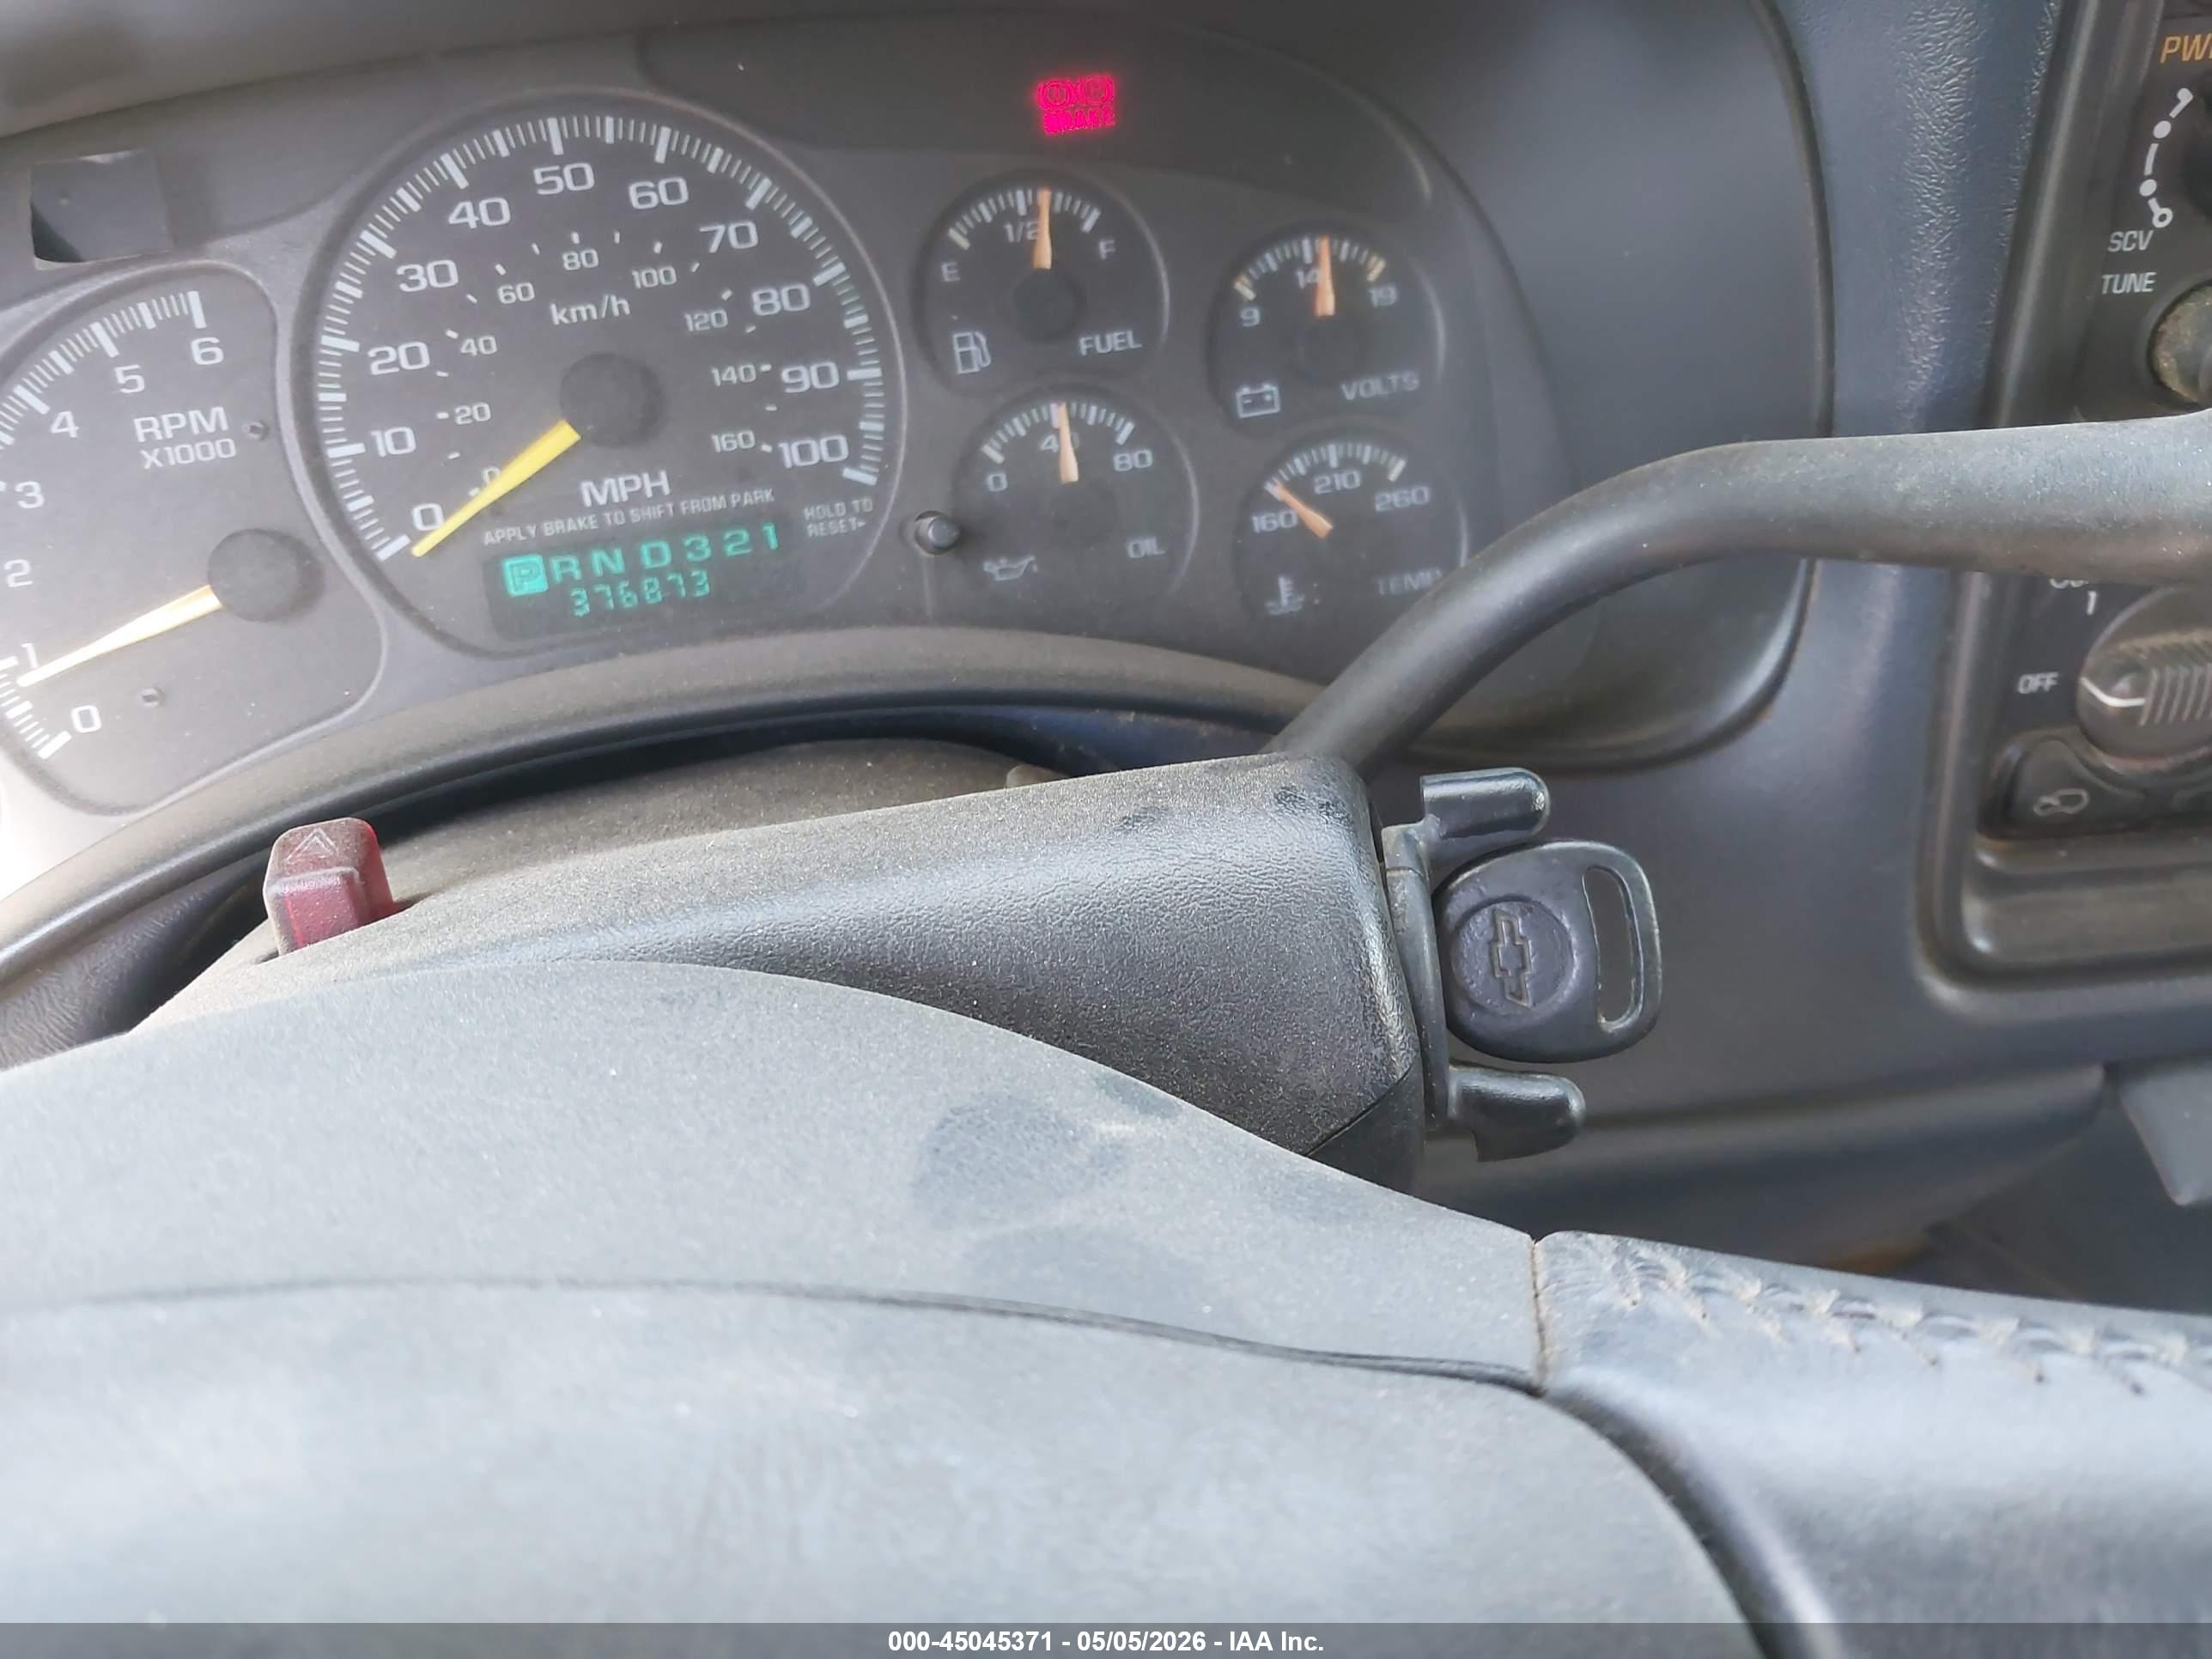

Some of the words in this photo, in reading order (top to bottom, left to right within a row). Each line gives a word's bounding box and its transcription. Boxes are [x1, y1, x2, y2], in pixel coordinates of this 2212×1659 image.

[2160, 33, 2212, 64] PW
[534, 162, 594, 195] 50
[629, 177, 689, 210] 60
[447, 197, 511, 229] 40
[699, 220, 758, 252] 70
[1098, 239, 1116, 260] F
[2107, 230, 2154, 252] SCV
[562, 249, 599, 271] 80
[941, 261, 961, 282] E
[396, 258, 458, 293] 30
[631, 264, 677, 288] 100
[2101, 271, 2156, 295] TUNE
[498, 281, 535, 304] 60
[752, 283, 811, 315] 80
[1368, 283, 1398, 307] 19
[550, 295, 630, 325] km/h
[684, 308, 728, 332] 120
[1240, 307, 1261, 327] 9
[191, 337, 225, 365] 6
[460, 335, 497, 357] 40
[1079, 330, 1143, 356] FUEL
[368, 341, 429, 375] 20
[113, 364, 146, 393] 5
[711, 363, 757, 386] 140
[781, 361, 840, 392] 90
[1340, 370, 1419, 401] VOLTS
[50, 410, 80, 438] 4
[133, 406, 229, 443] RPM
[454, 403, 492, 425] 20
[139, 438, 237, 470] X1000
[371, 427, 416, 457] 10
[712, 431, 755, 453] 160
[779, 434, 848, 468] 100
[1113, 449, 1153, 471] 80
[14, 481, 45, 508] 3
[580, 470, 672, 507] MPH
[988, 472, 1008, 492] 0
[1314, 471, 1362, 495] 210
[804, 501, 847, 521] HOLD
[851, 497, 874, 514] TO
[1375, 485, 1430, 512] 260
[411, 502, 445, 532] 0
[483, 523, 538, 546] APPLY
[543, 514, 599, 537] BRAKE
[604, 510, 626, 526] TO
[629, 503, 674, 525] SHIFT
[680, 495, 727, 515] FROM
[731, 488, 775, 508] PARK
[806, 517, 858, 538] RESET
[1250, 510, 1298, 533] 160
[549, 555, 584, 584] R
[590, 548, 626, 577] N
[640, 540, 672, 569] D
[683, 534, 713, 562] 3
[723, 528, 753, 557] 2
[763, 522, 779, 550] 1
[1127, 536, 1166, 559] OIL
[3, 558, 33, 588] 2
[21, 641, 40, 670] 1
[2016, 672, 2060, 695] OFF
[70, 703, 102, 733] 0
